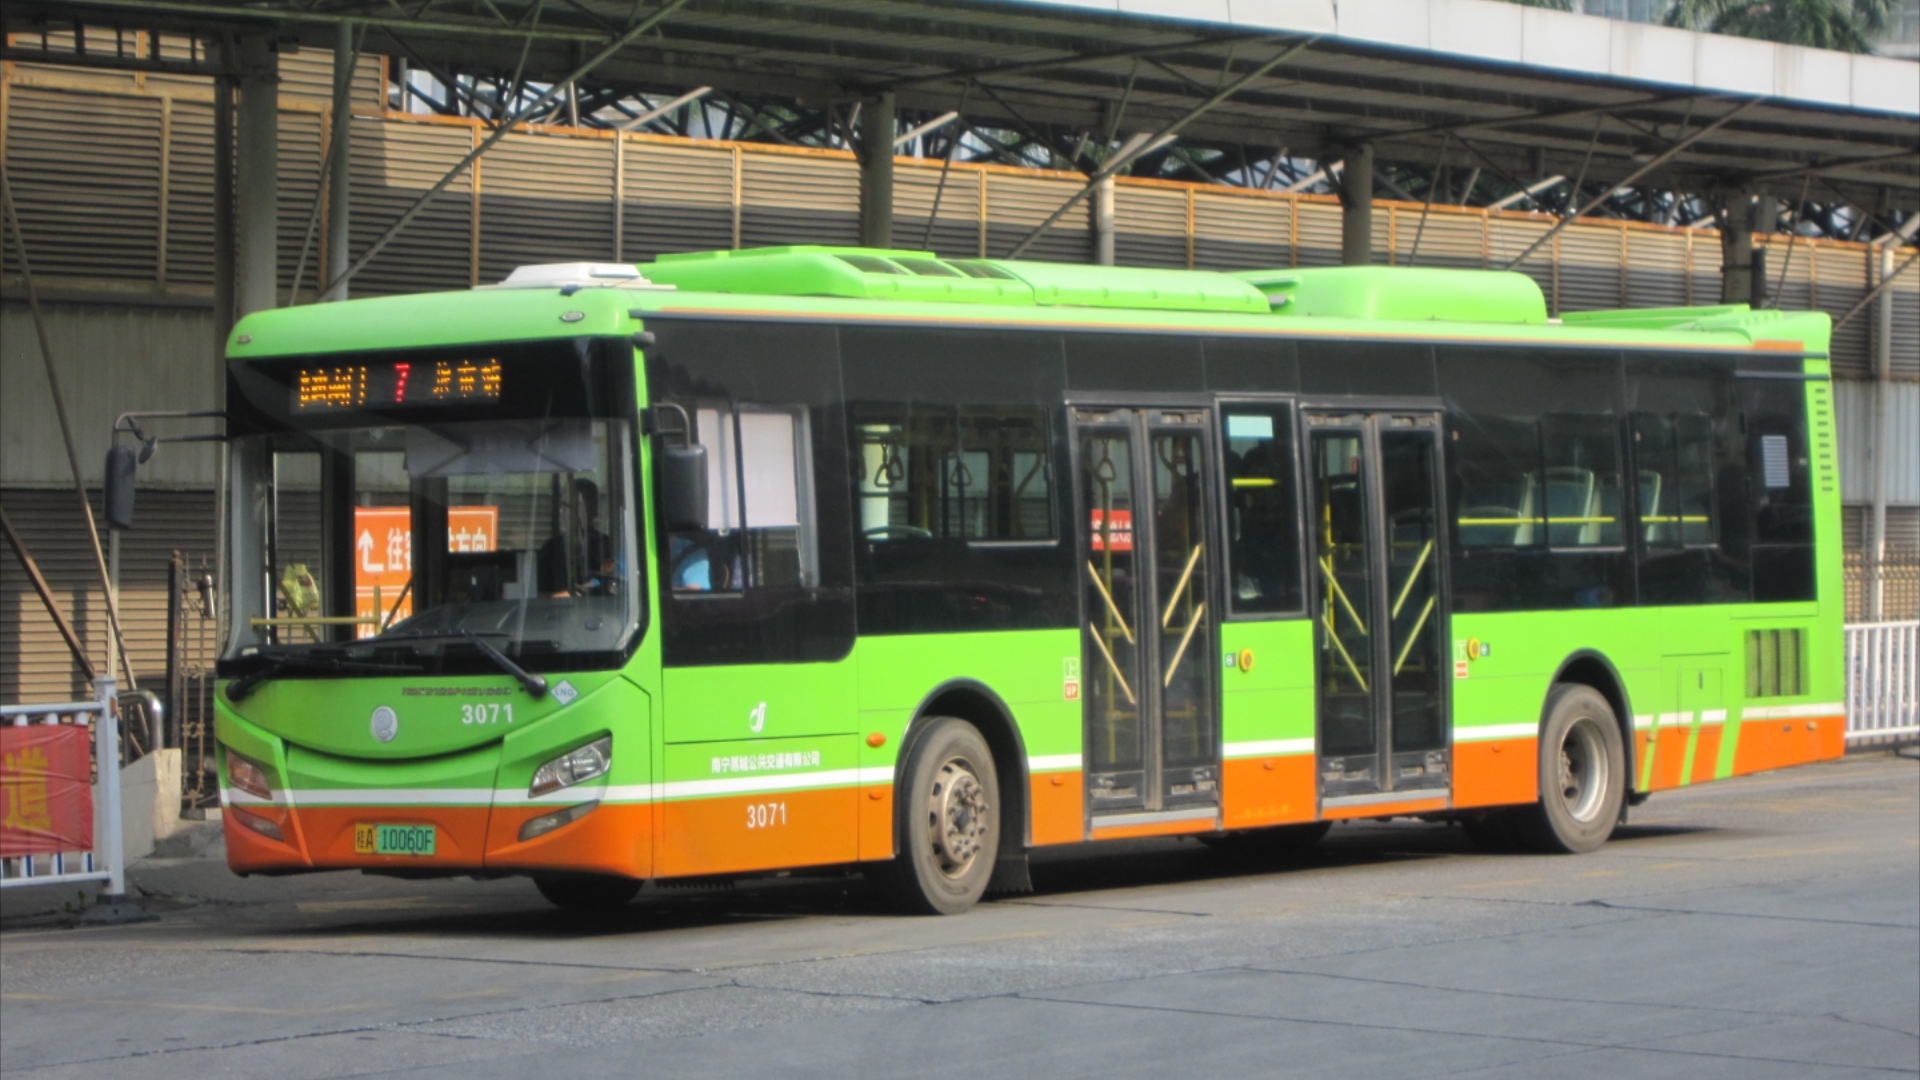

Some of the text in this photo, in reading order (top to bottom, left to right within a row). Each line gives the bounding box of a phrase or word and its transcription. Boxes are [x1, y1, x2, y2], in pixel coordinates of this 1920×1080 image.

[395, 363, 410, 402] 7
[554, 687, 574, 697] LNG
[1065, 685, 1077, 696] UP
[461, 703, 513, 724] 3071
[747, 802, 786, 828] 3071
